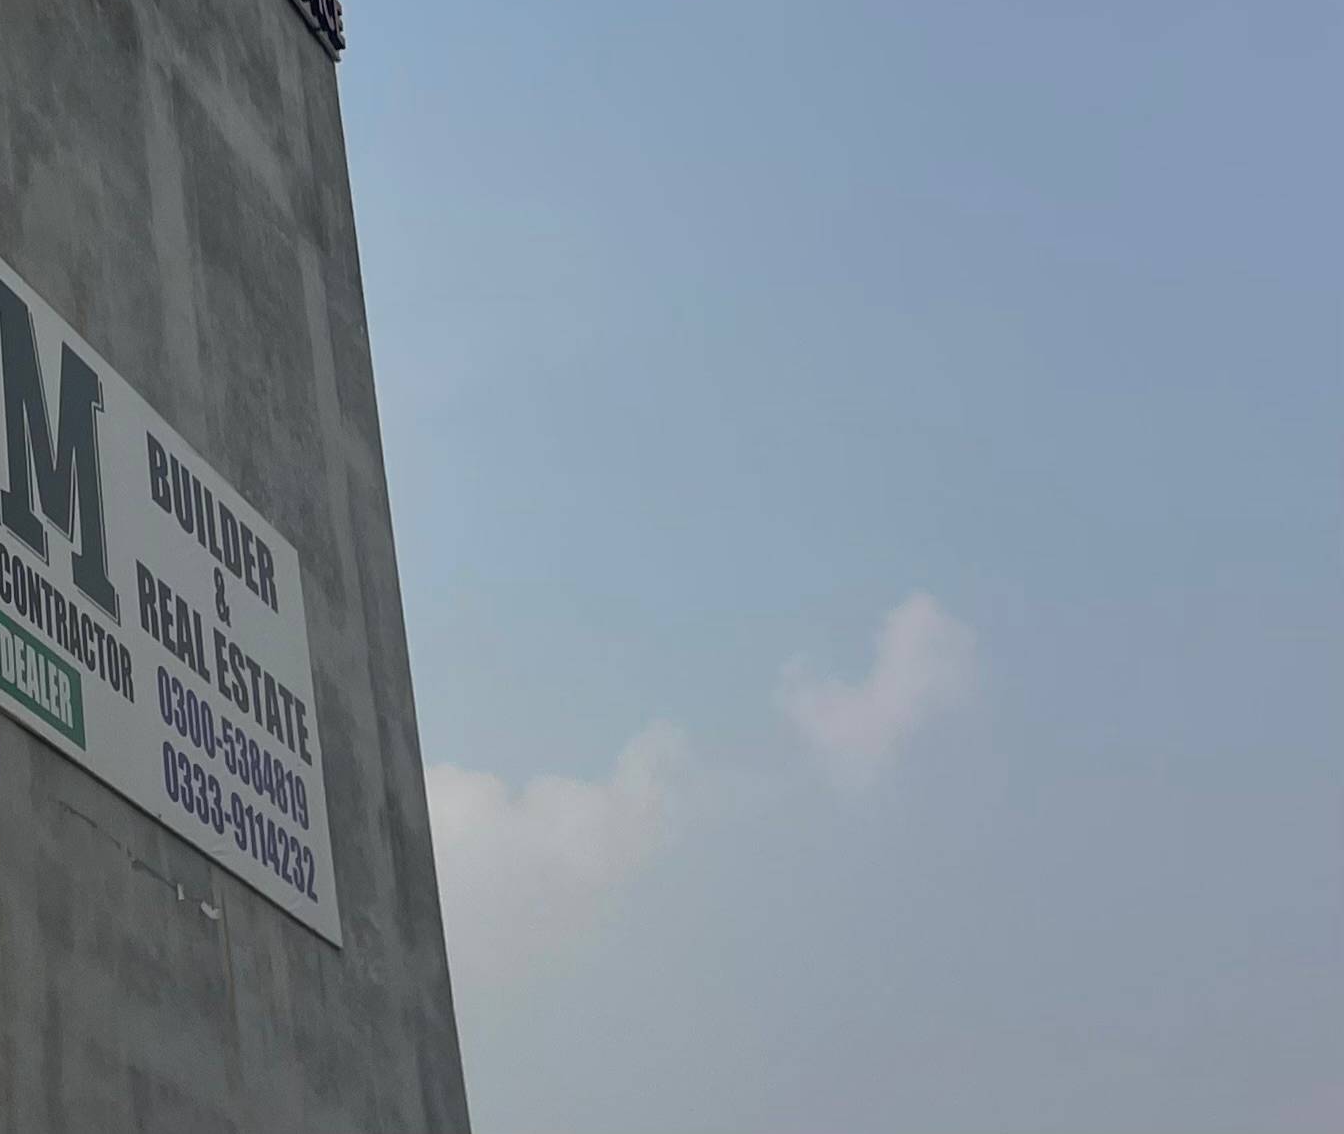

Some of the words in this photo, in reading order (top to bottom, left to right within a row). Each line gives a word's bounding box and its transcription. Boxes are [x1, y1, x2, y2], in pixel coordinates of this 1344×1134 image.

[146, 430, 279, 614] BUILDER
[214, 567, 231, 628] &
[136, 558, 211, 685] REAL
[213, 626, 313, 767] ESTATE
[156, 666, 311, 831] 0300-5384819
[162, 740, 319, 904] 0333-9114232
